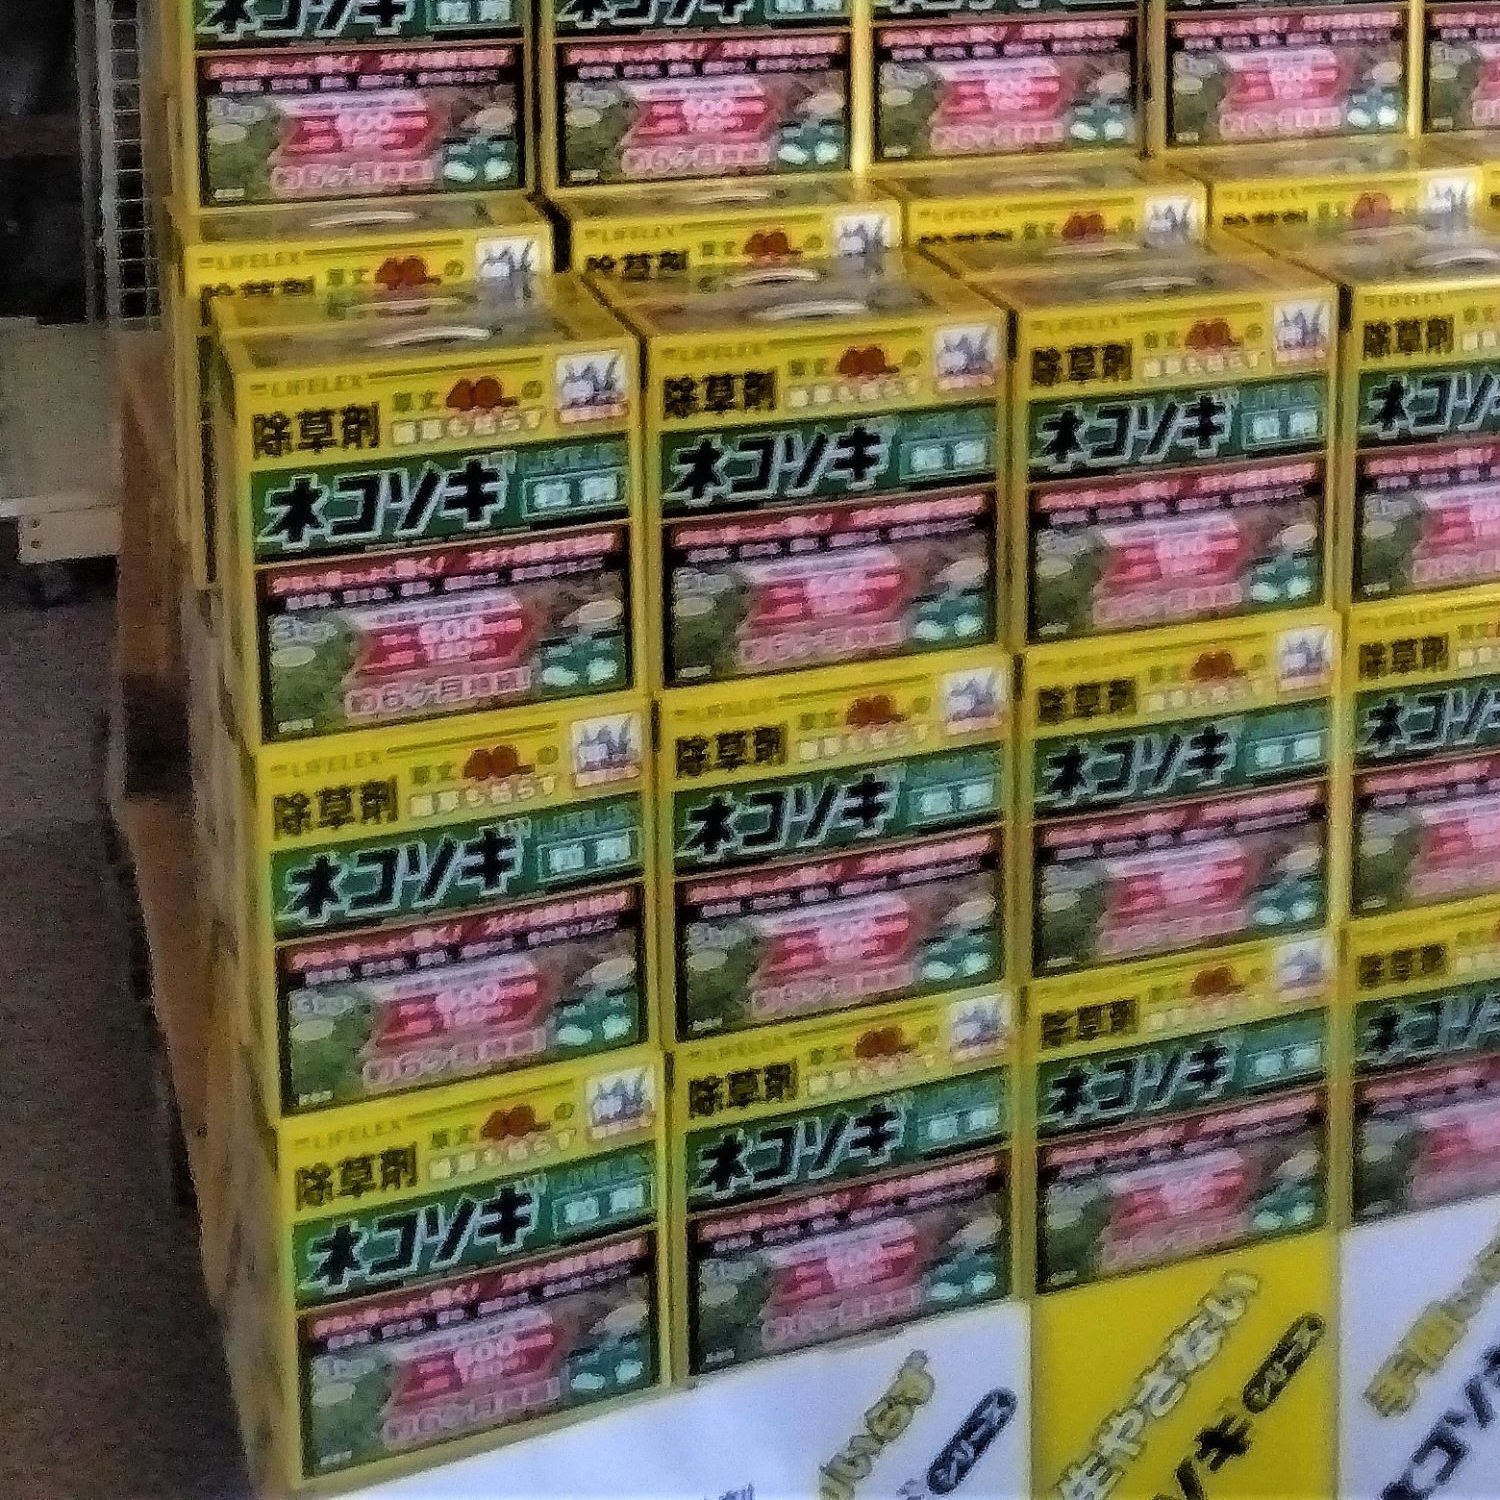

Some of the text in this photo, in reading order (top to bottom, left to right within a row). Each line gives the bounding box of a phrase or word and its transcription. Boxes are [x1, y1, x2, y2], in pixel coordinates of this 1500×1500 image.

[255, 448, 519, 552] ネコソギ
[661, 414, 899, 509] ネコソギ
[277, 815, 533, 929] ネコソギ
[296, 1172, 549, 1297] ネコソギ
